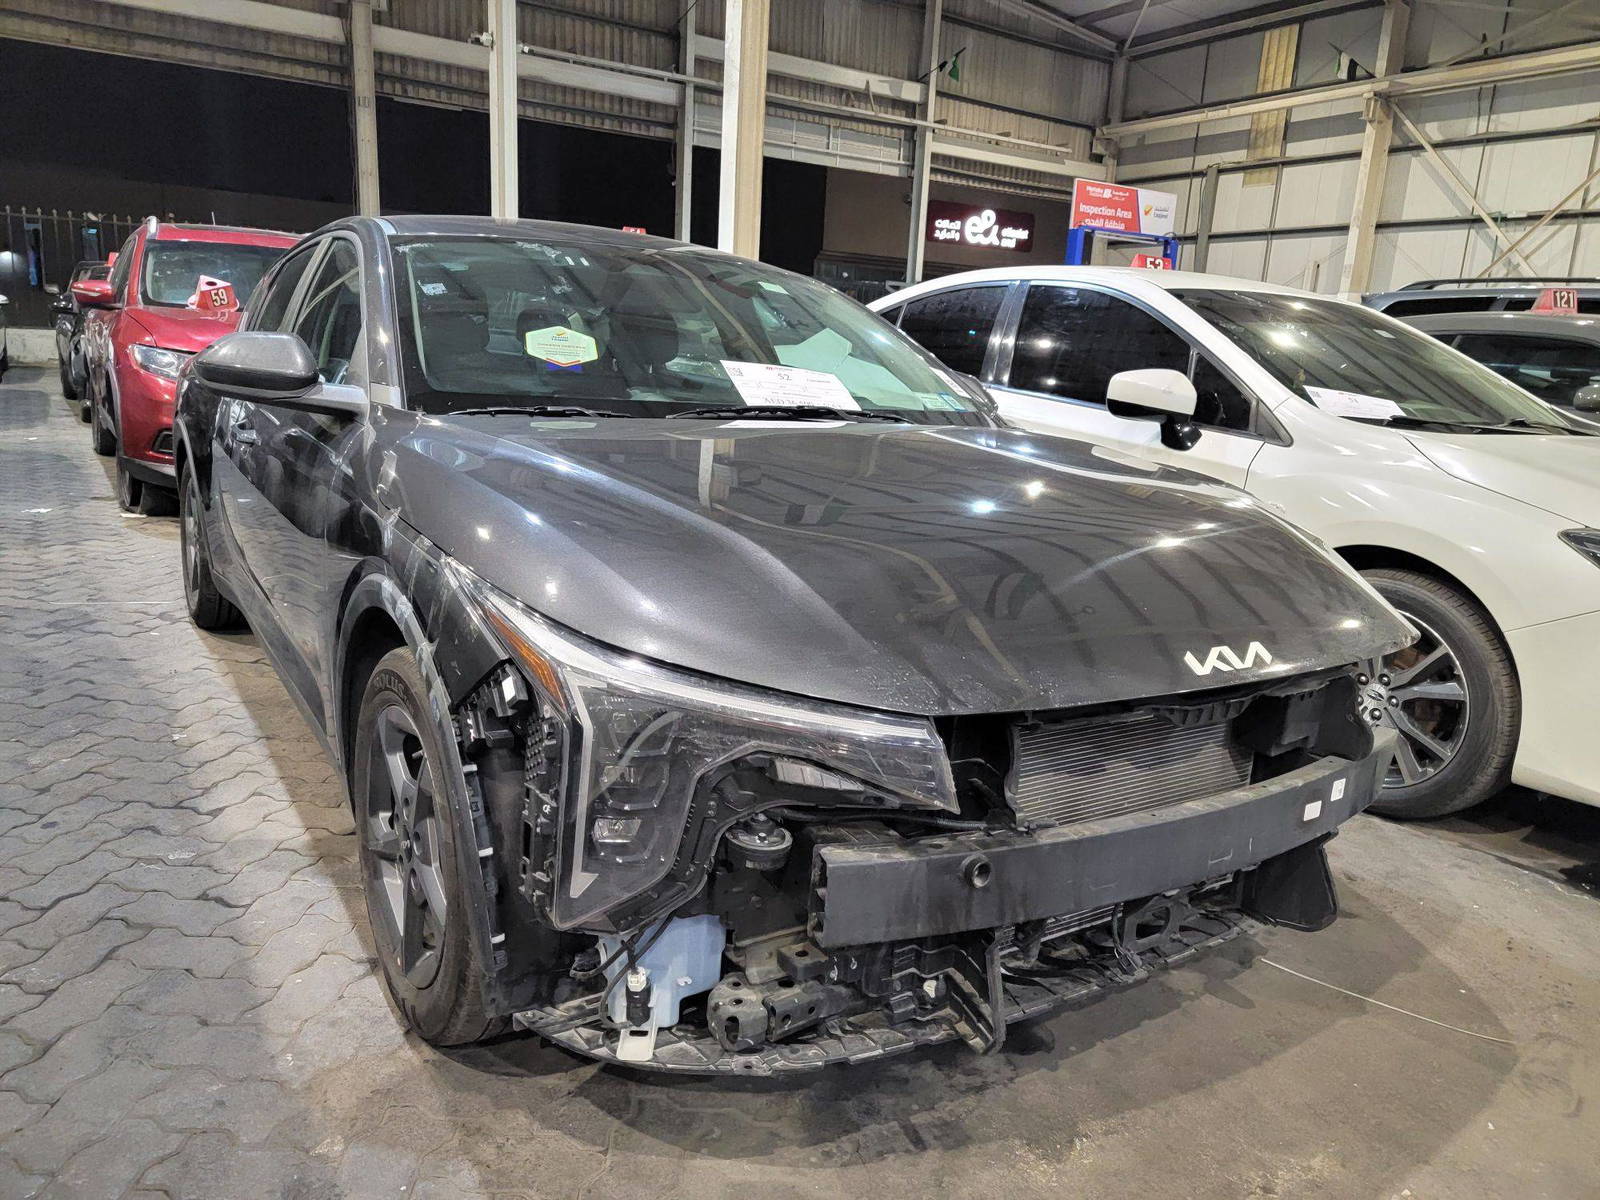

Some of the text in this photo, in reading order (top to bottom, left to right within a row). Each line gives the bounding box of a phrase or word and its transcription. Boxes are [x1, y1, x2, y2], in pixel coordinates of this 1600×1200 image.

[1080, 202, 1132, 219] Inspection Area
[1104, 218, 1125, 230] منطقة
[210, 289, 228, 307] 59
[1554, 291, 1574, 308] 121
